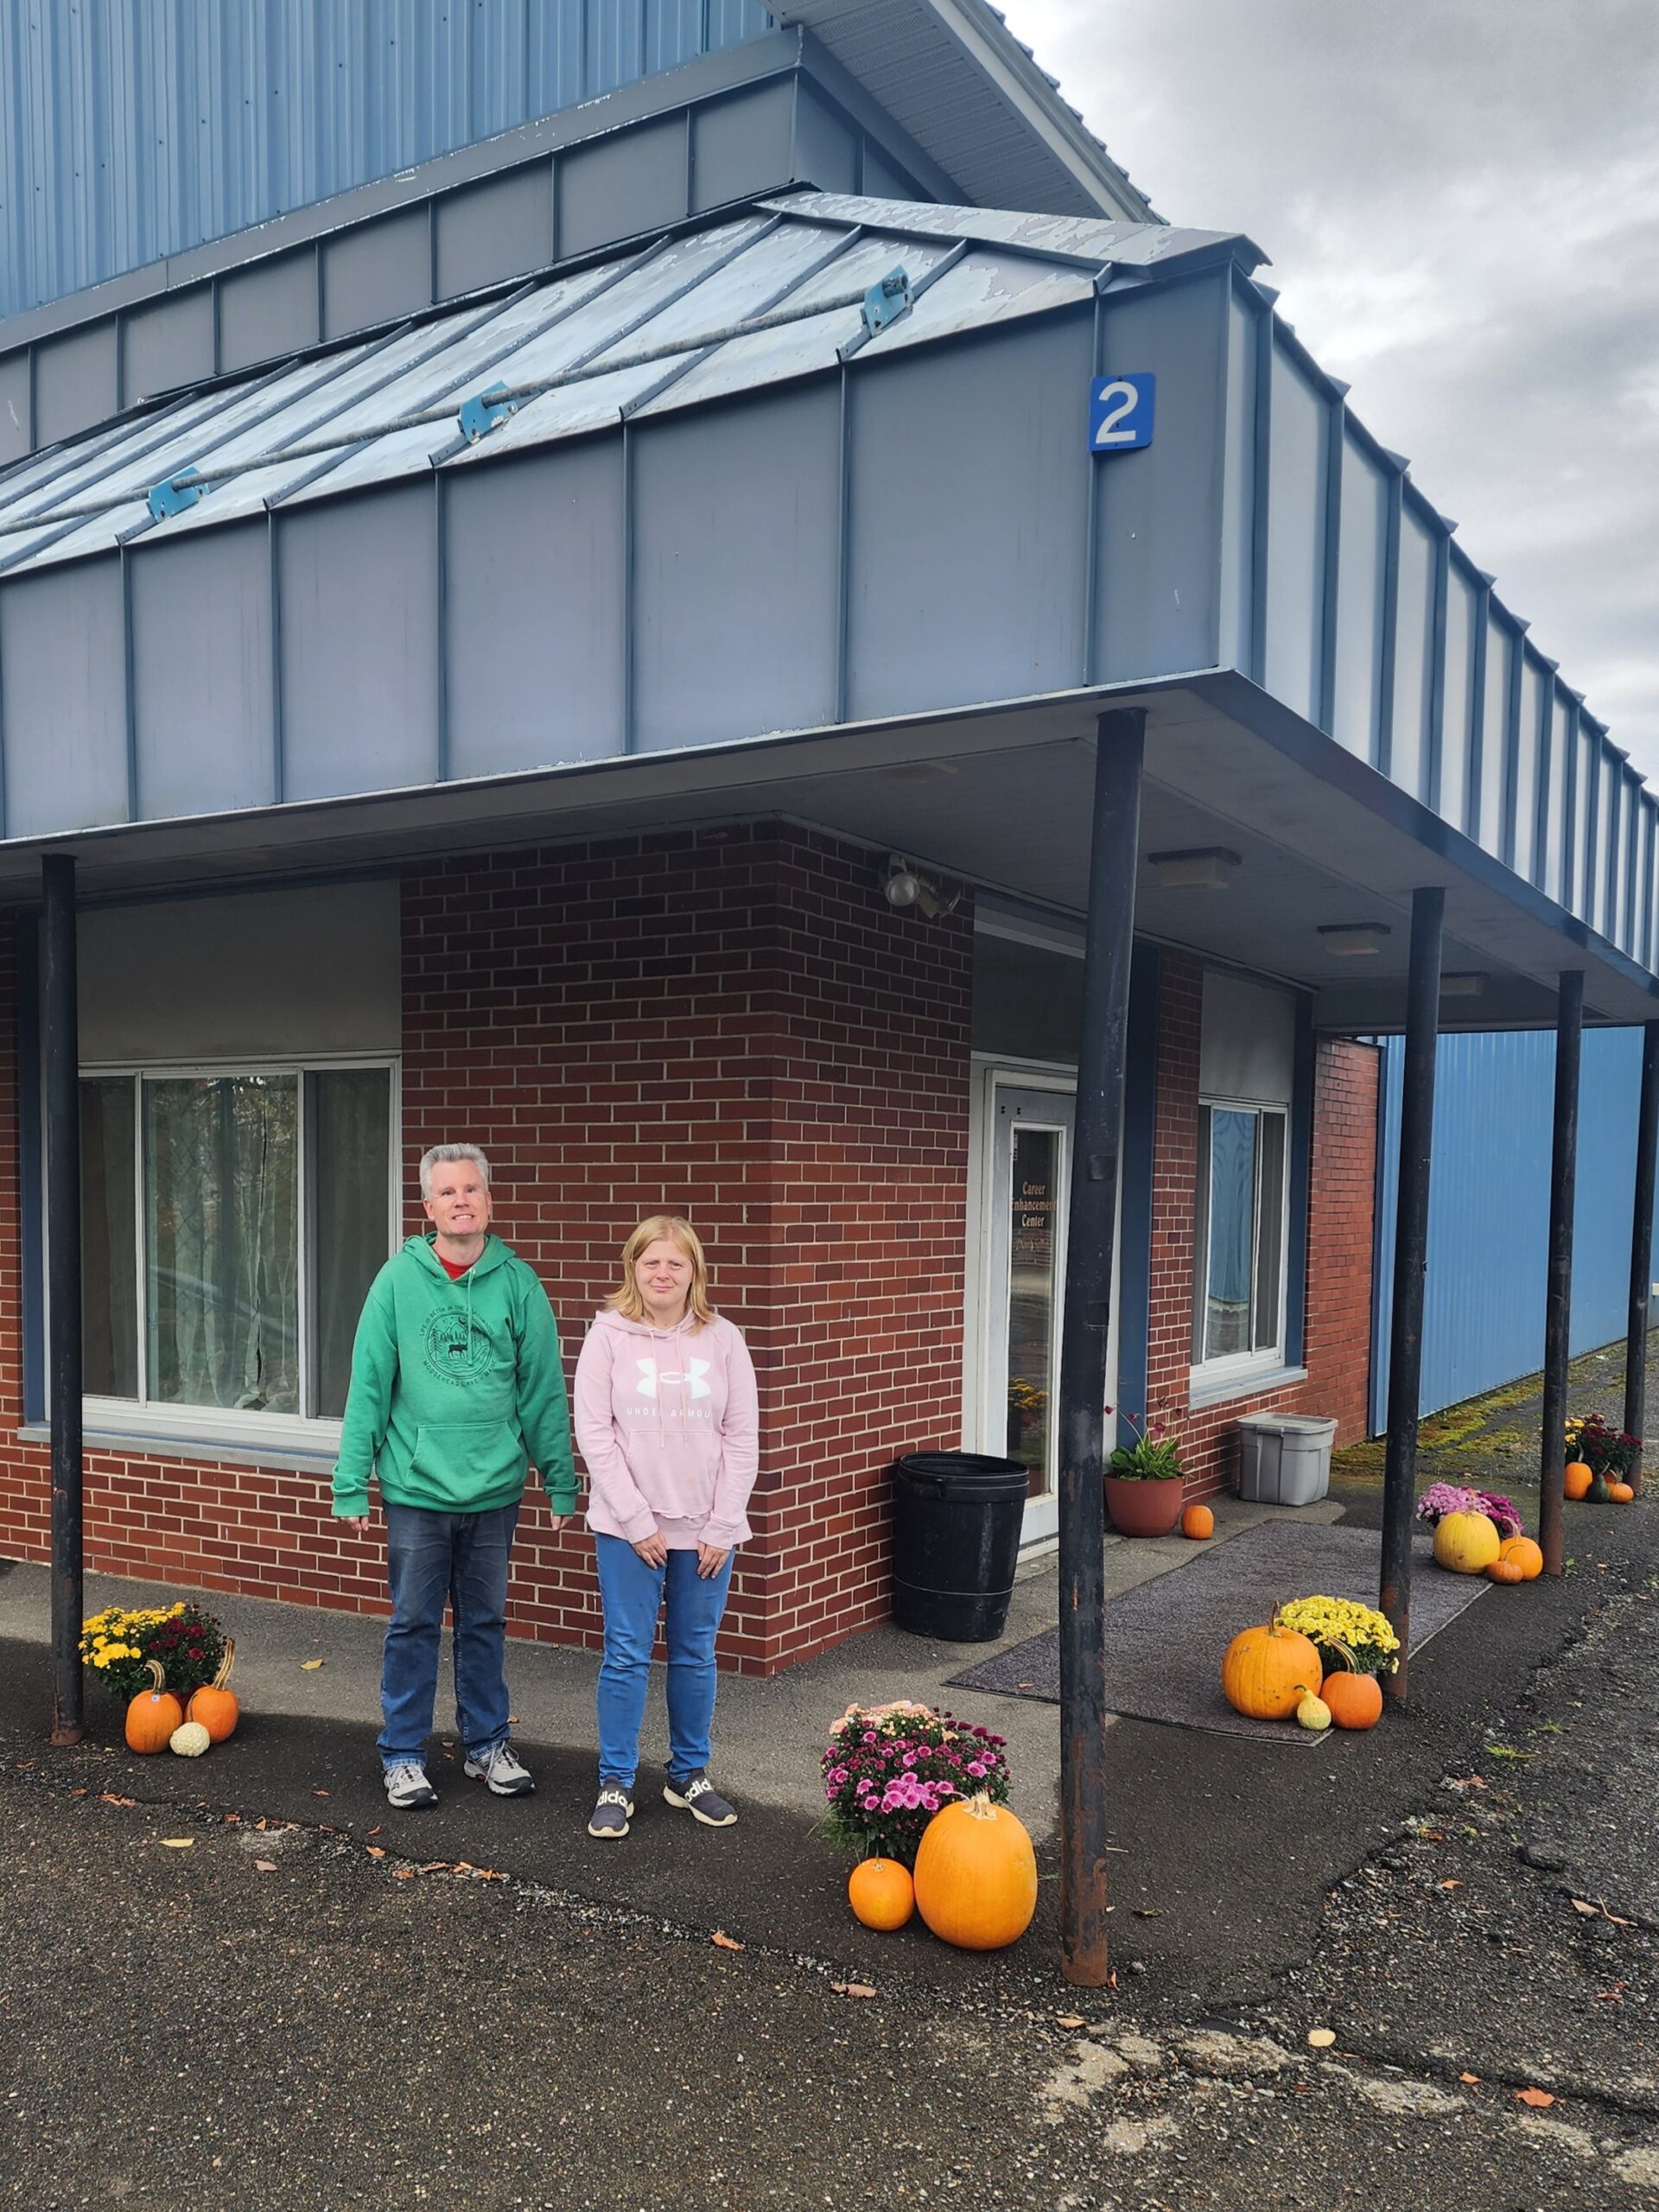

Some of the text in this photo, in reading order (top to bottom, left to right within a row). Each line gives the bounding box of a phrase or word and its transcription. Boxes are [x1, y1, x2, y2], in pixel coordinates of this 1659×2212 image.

[1095, 381, 1138, 444] 2
[1023, 1181, 1046, 1195] Career
[1022, 1214, 1045, 1227] Center
[423, 1360, 461, 1386] MOOSEHEAD
[627, 1407, 657, 1416] UNDE
[595, 1789, 628, 1809] dida
[684, 1777, 714, 1802] adid
